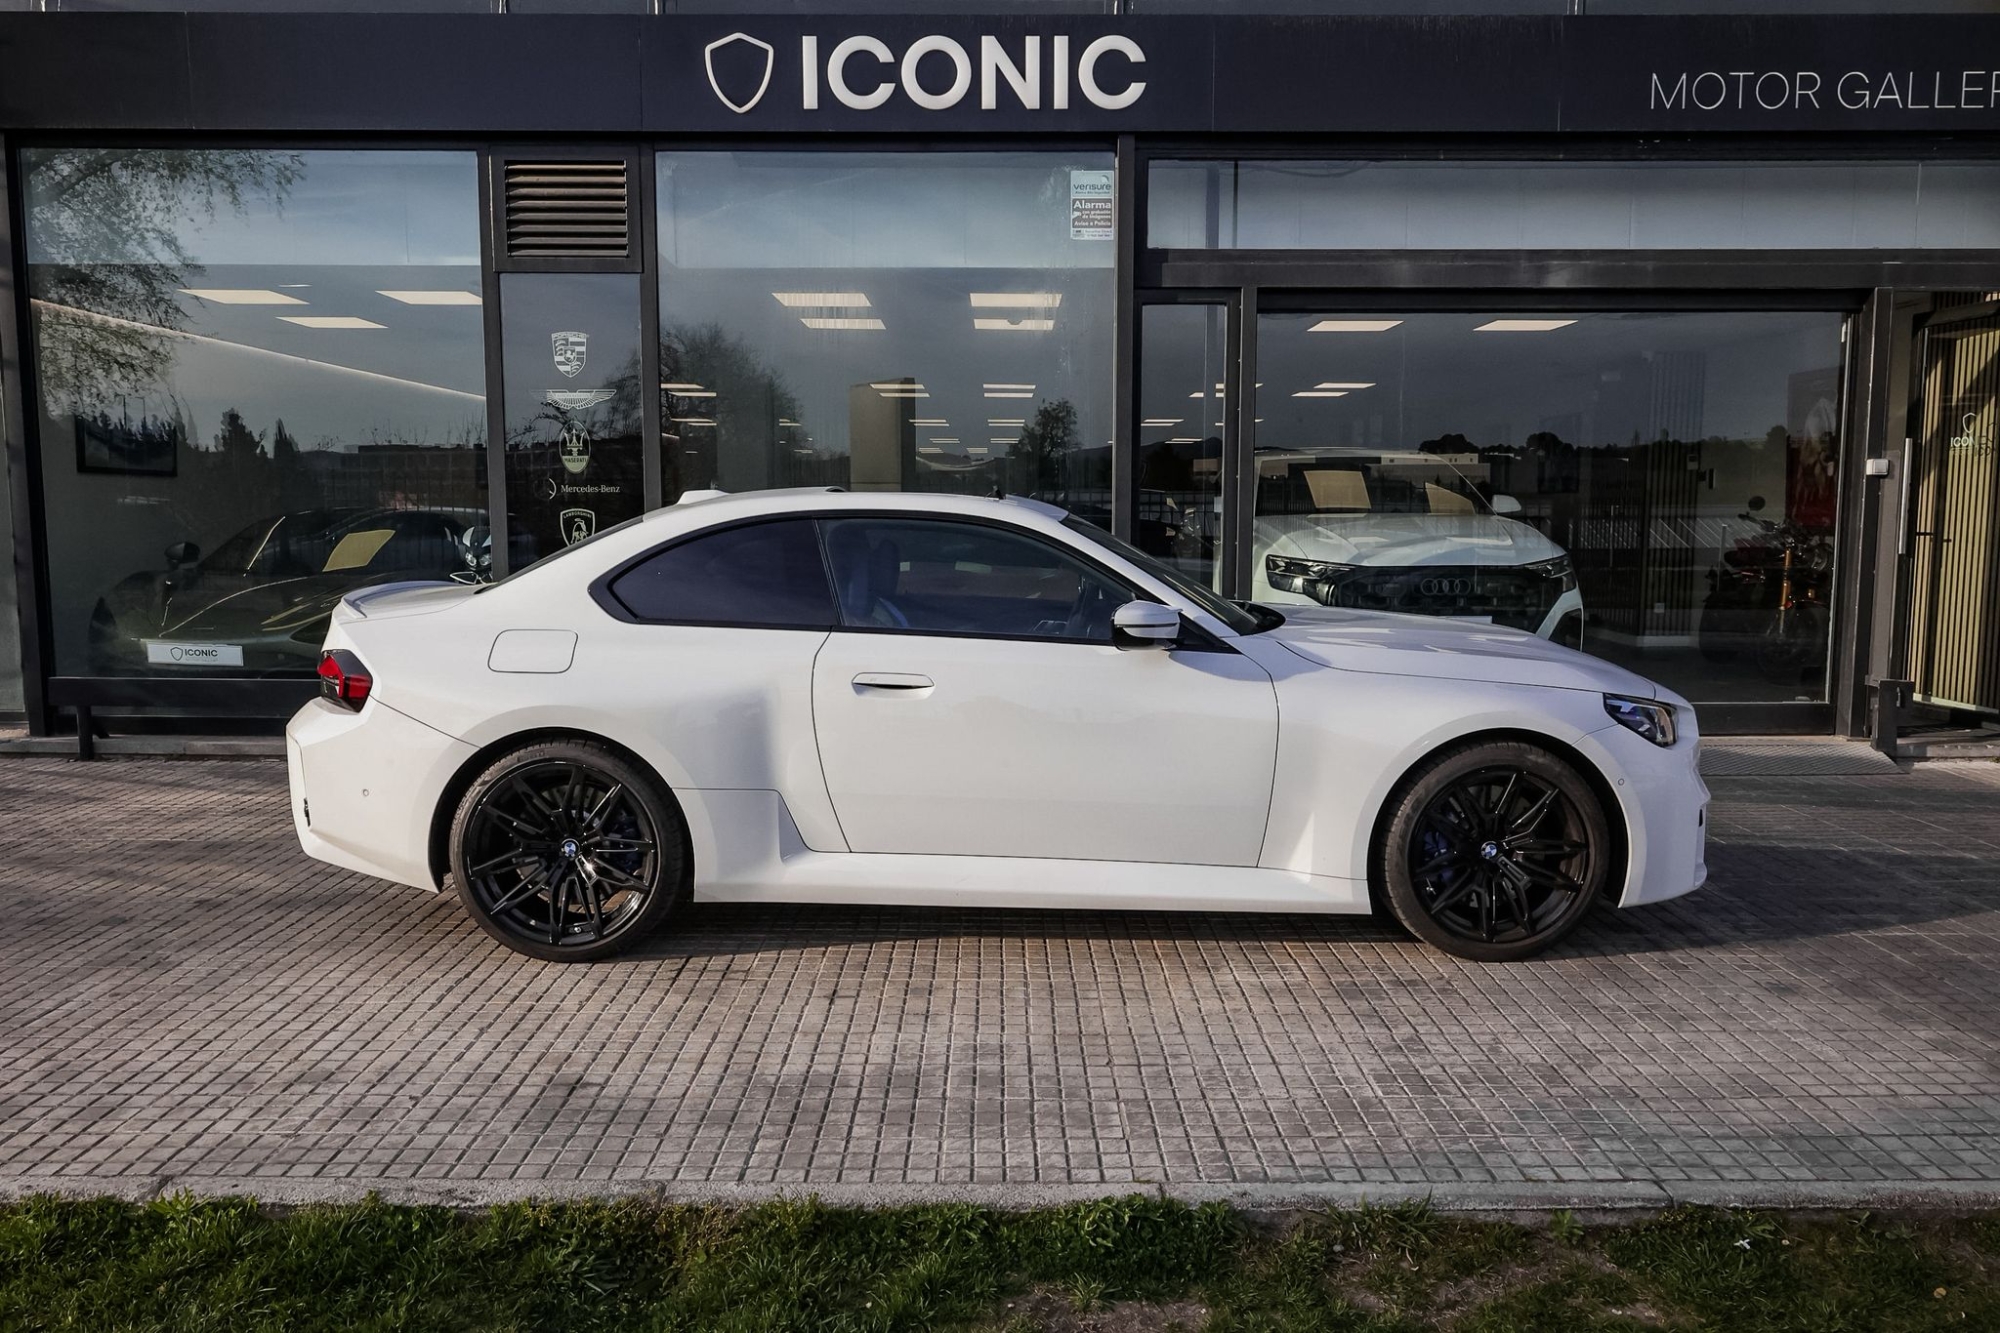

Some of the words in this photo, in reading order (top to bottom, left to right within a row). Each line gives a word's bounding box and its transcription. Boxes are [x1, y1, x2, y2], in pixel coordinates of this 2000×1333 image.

[802, 35, 1147, 110] ICONIC
[1651, 71, 1820, 109] MOTOR
[1073, 200, 1111, 209] Alarma
[561, 484, 621, 493] Mercedes-Benz
[185, 648, 218, 657] ICONIC
